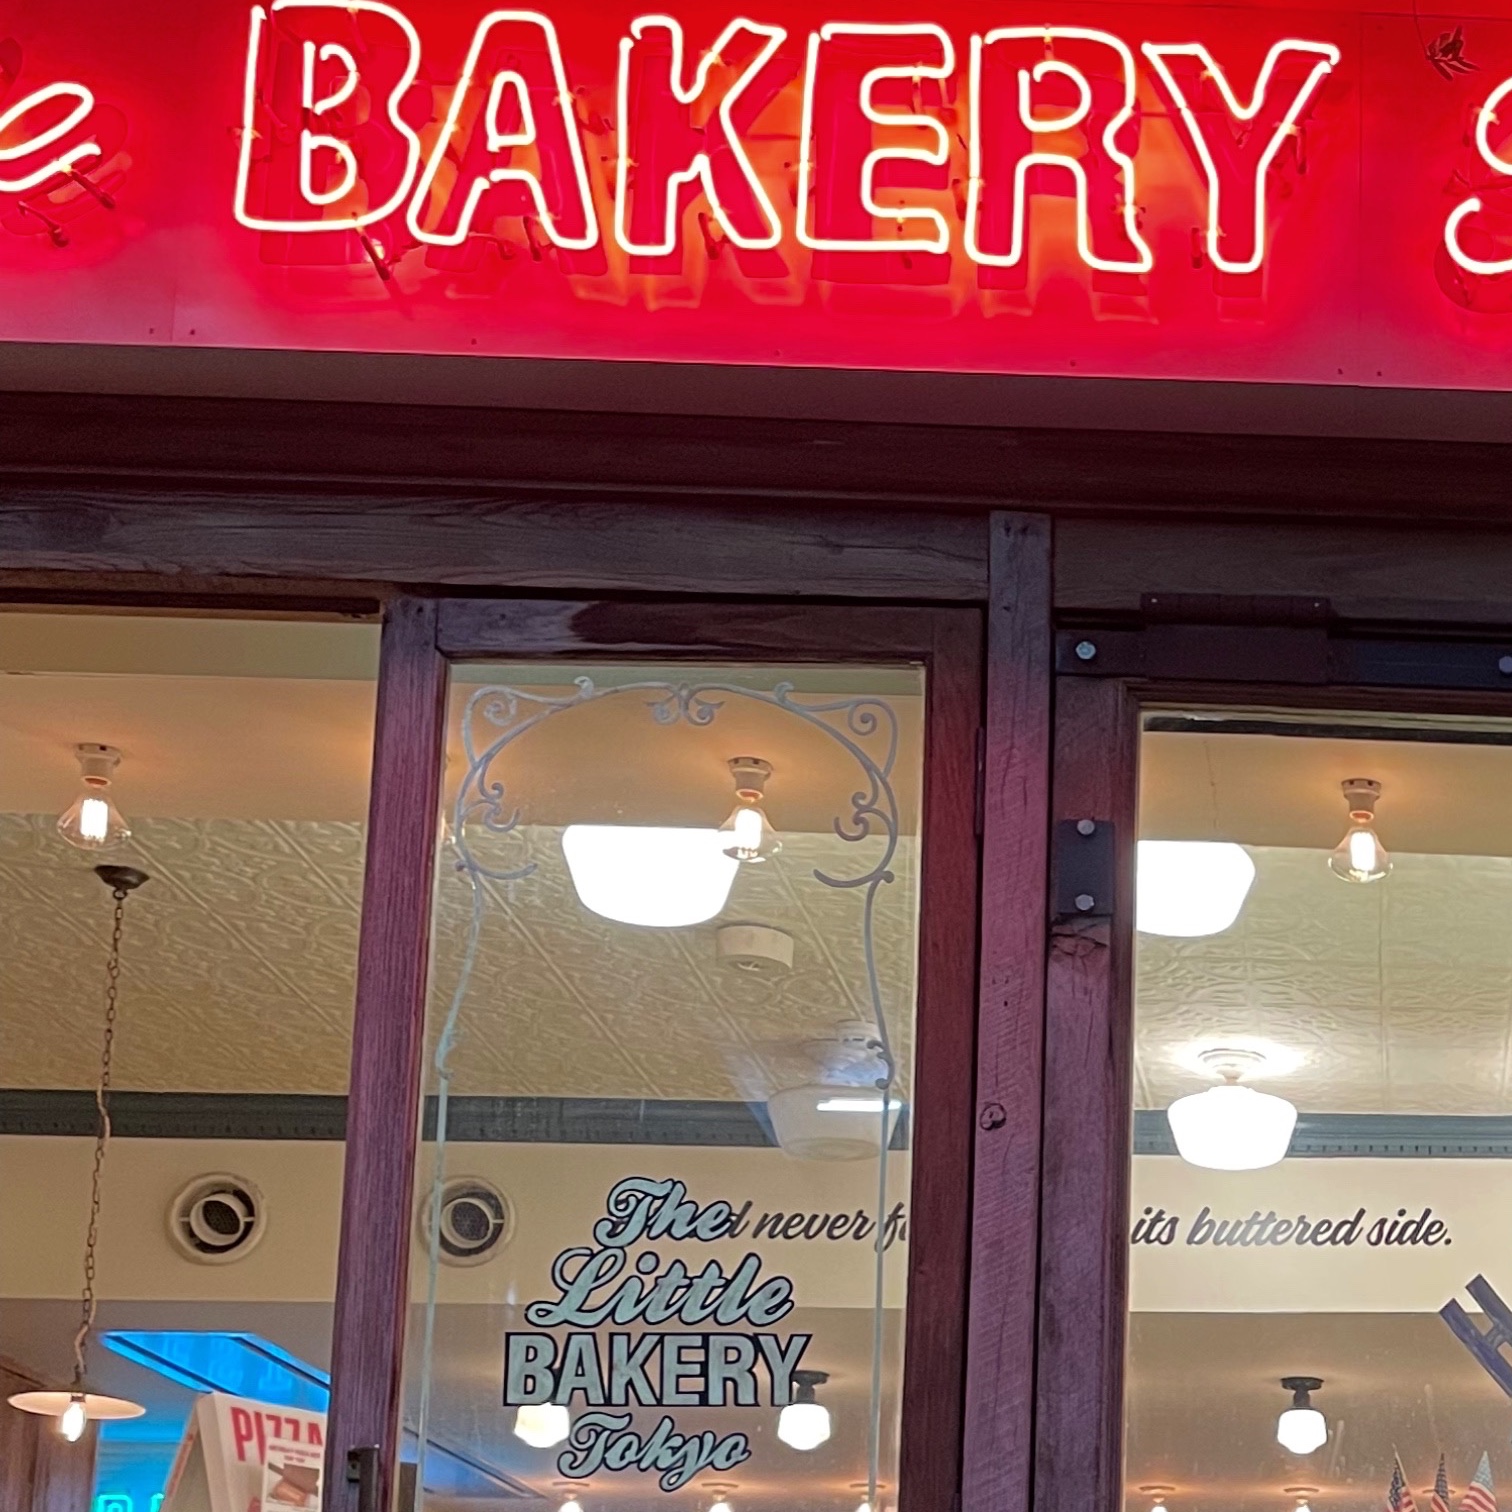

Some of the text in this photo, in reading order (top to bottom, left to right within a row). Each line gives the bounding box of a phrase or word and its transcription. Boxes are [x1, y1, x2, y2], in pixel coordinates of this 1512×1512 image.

[234, 0, 1340, 273] BAKERY
[593, 1176, 734, 1248] The
[752, 1210, 876, 1241] never
[1132, 1209, 1179, 1246] its
[1186, 1207, 1364, 1247] buttered
[1367, 1207, 1452, 1246] side.
[525, 1246, 795, 1329] Little
[503, 1331, 813, 1408] BAKERY
[557, 1412, 752, 1492] Tokyo
